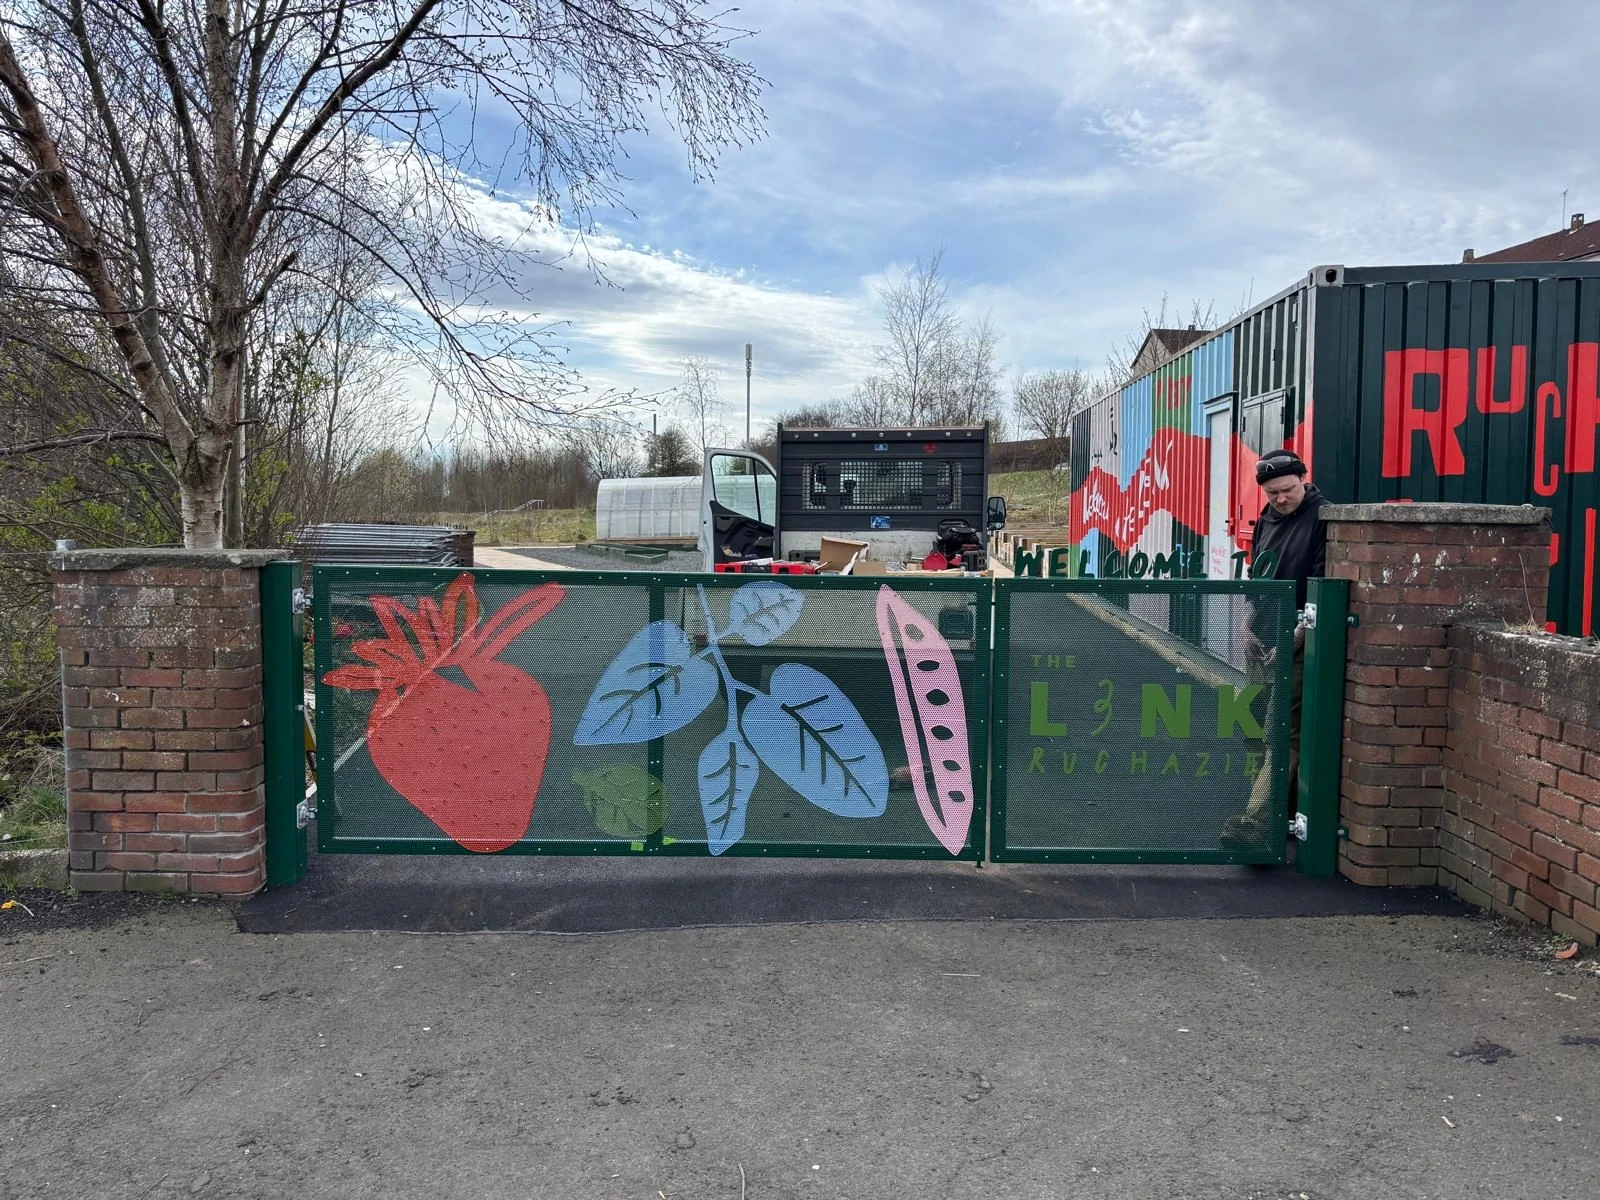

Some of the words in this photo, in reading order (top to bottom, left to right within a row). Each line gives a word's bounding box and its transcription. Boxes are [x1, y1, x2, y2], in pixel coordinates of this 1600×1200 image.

[1014, 547, 1208, 579] WELCOME
[1231, 550, 1281, 580] TO
[1032, 655, 1076, 669] THE
